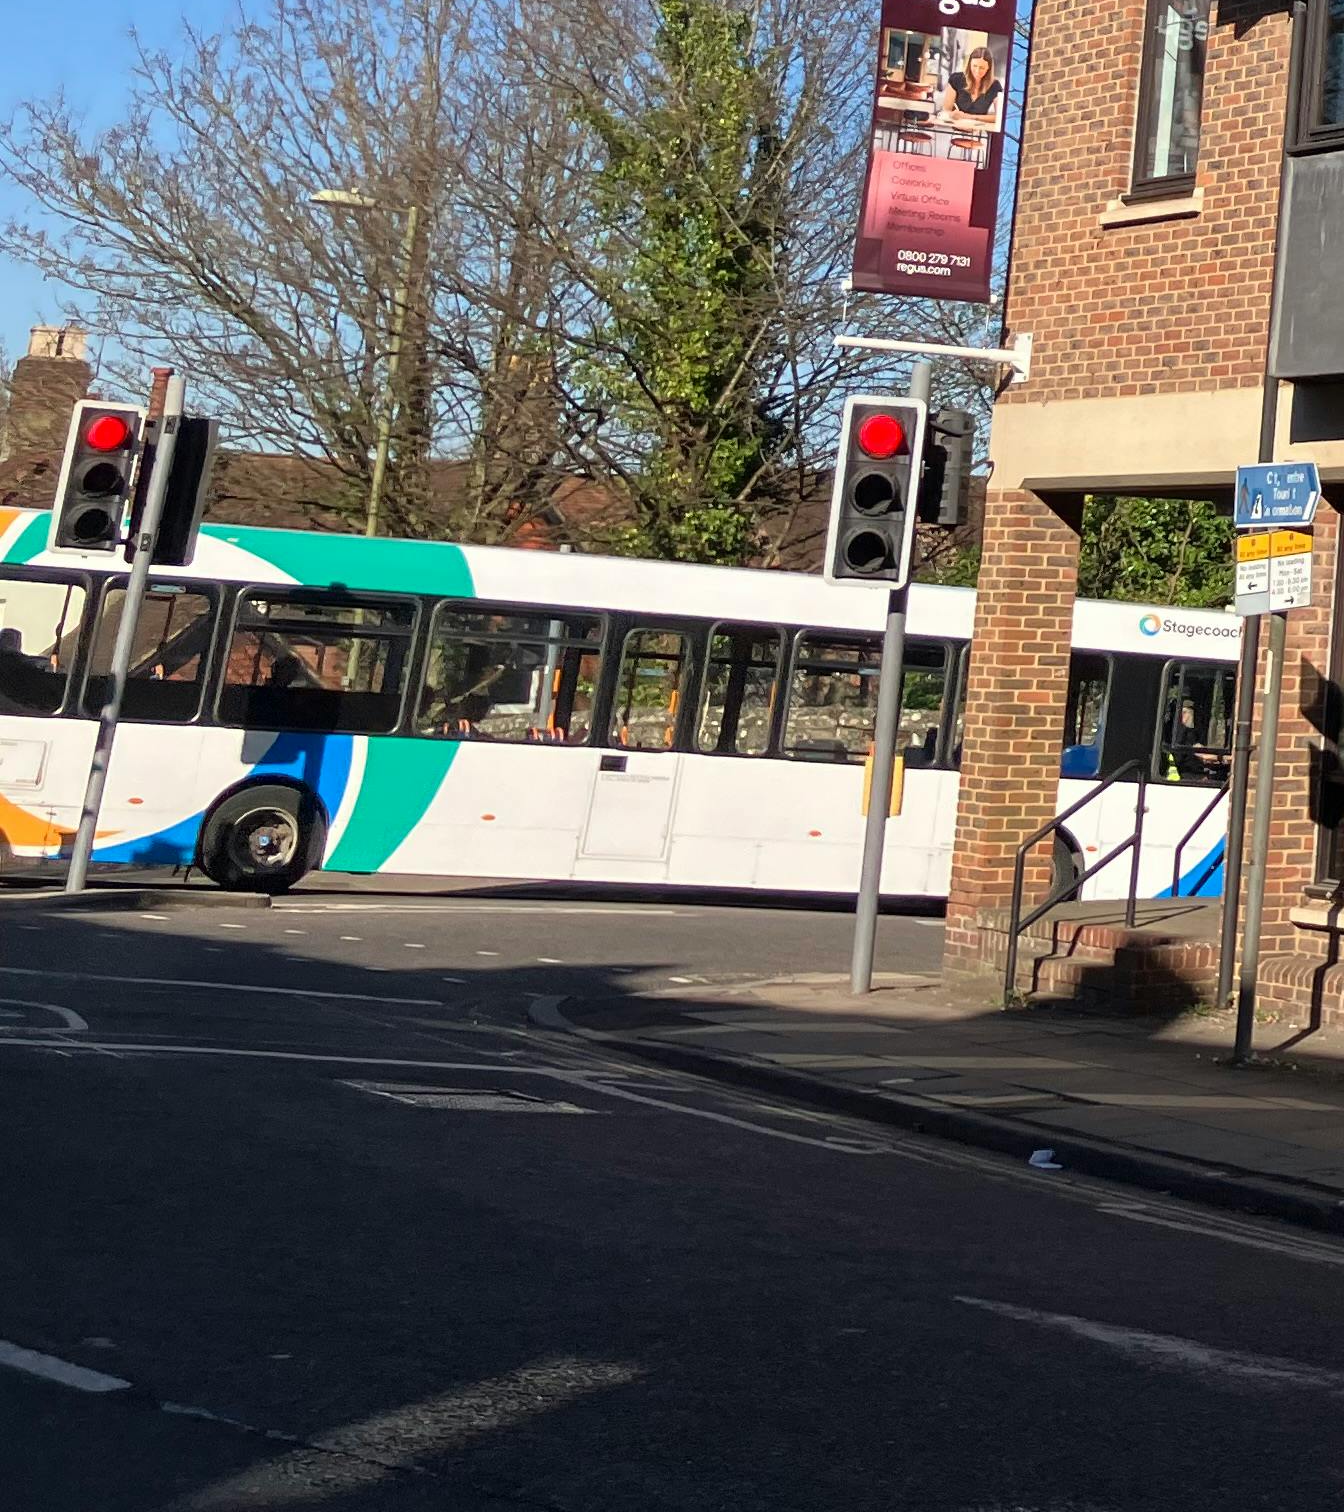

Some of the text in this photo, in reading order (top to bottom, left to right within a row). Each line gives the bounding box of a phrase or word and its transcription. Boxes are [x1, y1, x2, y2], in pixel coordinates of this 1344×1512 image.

[891, 175, 942, 191] Coworking
[891, 191, 950, 205] Virtual Office
[889, 206, 961, 222] Meeting Rooms
[897, 249, 971, 267] 0800 279 7131
